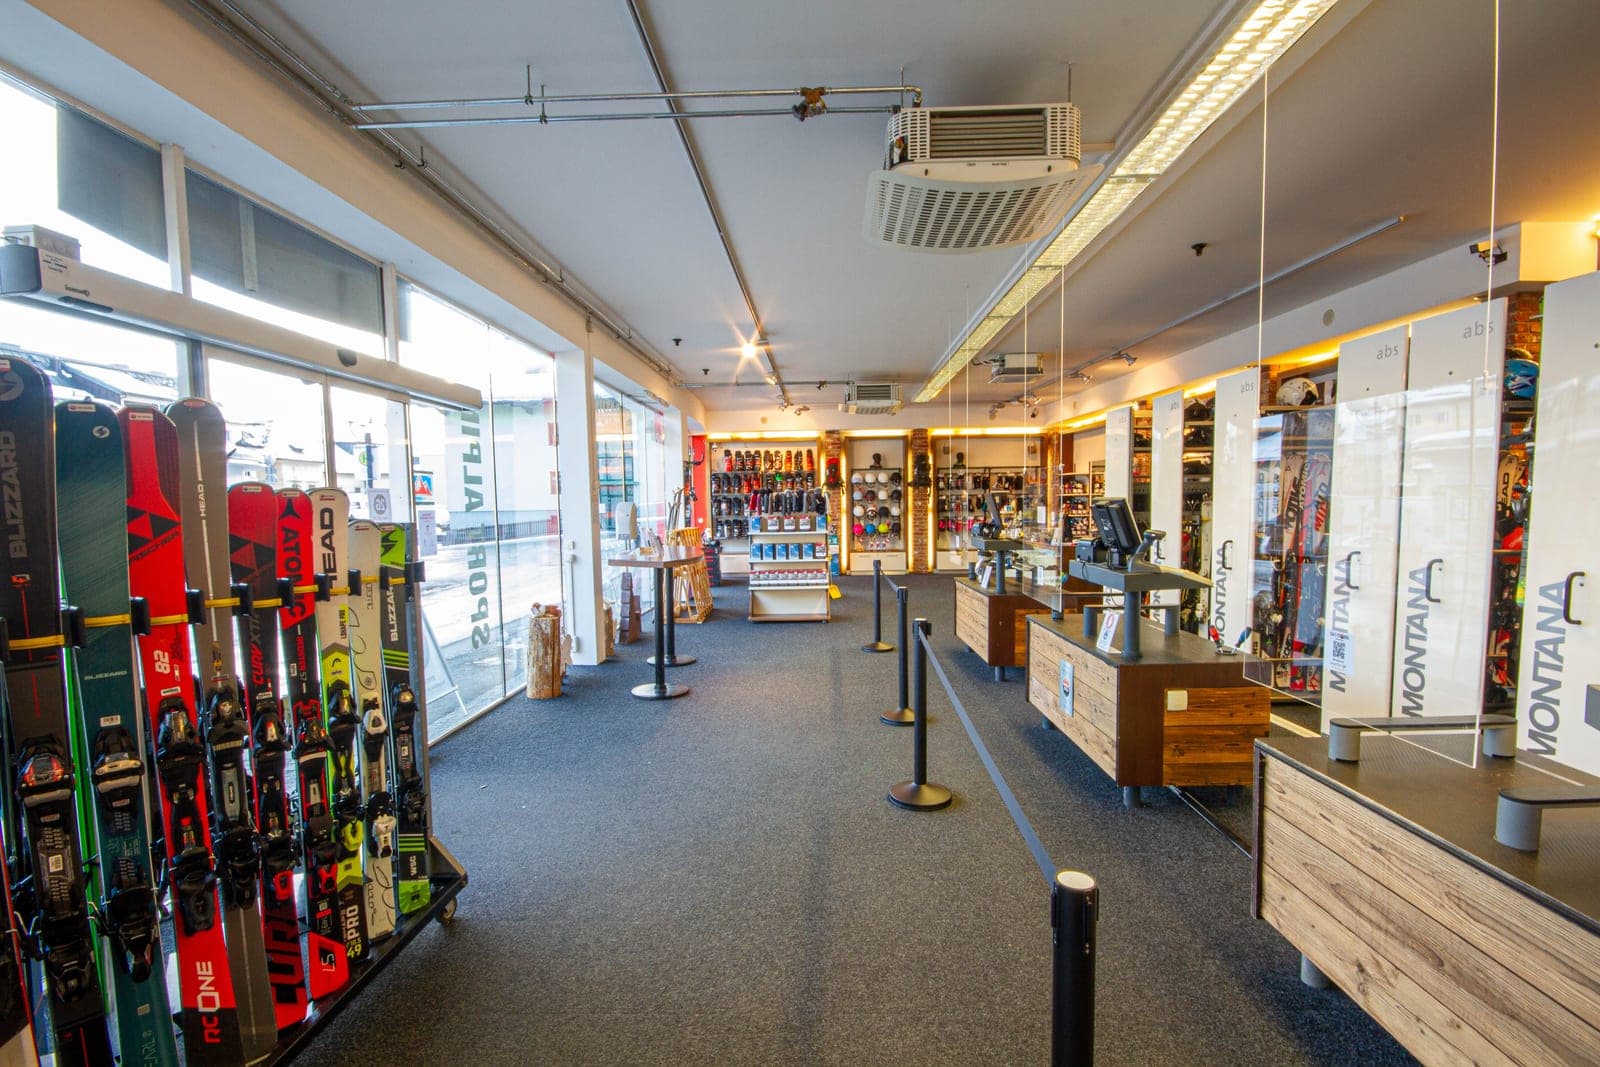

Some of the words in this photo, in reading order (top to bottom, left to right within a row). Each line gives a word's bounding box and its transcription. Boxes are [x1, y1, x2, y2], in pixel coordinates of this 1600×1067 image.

[1463, 320, 1494, 340] abs
[1376, 343, 1399, 360] abs
[1240, 380, 1254, 393] abs
[0, 431, 28, 559] BLIZZARD
[197, 483, 207, 517] HEAD
[1401, 566, 1430, 718] MONTANA
[153, 650, 170, 674] 82
[1527, 580, 1567, 757] MONTANA
[345, 904, 360, 941] PRO
[196, 960, 220, 1013] ONE
[202, 1015, 221, 1044] RC
